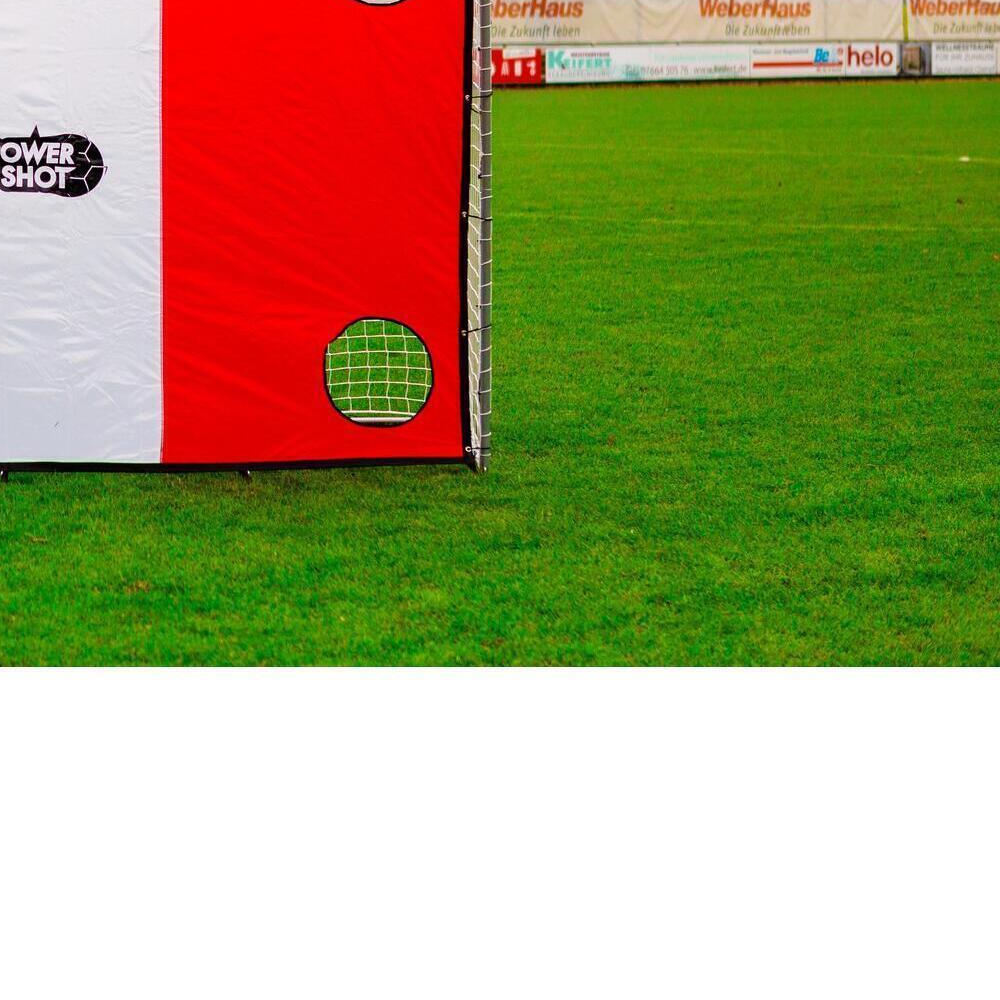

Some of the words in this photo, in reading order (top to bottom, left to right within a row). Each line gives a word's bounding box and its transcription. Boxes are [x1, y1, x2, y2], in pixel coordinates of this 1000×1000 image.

[510, 24, 550, 38] Zukunft
[553, 24, 581, 37] leben
[847, 44, 894, 67] helo
[1, 165, 77, 189] SHOT
